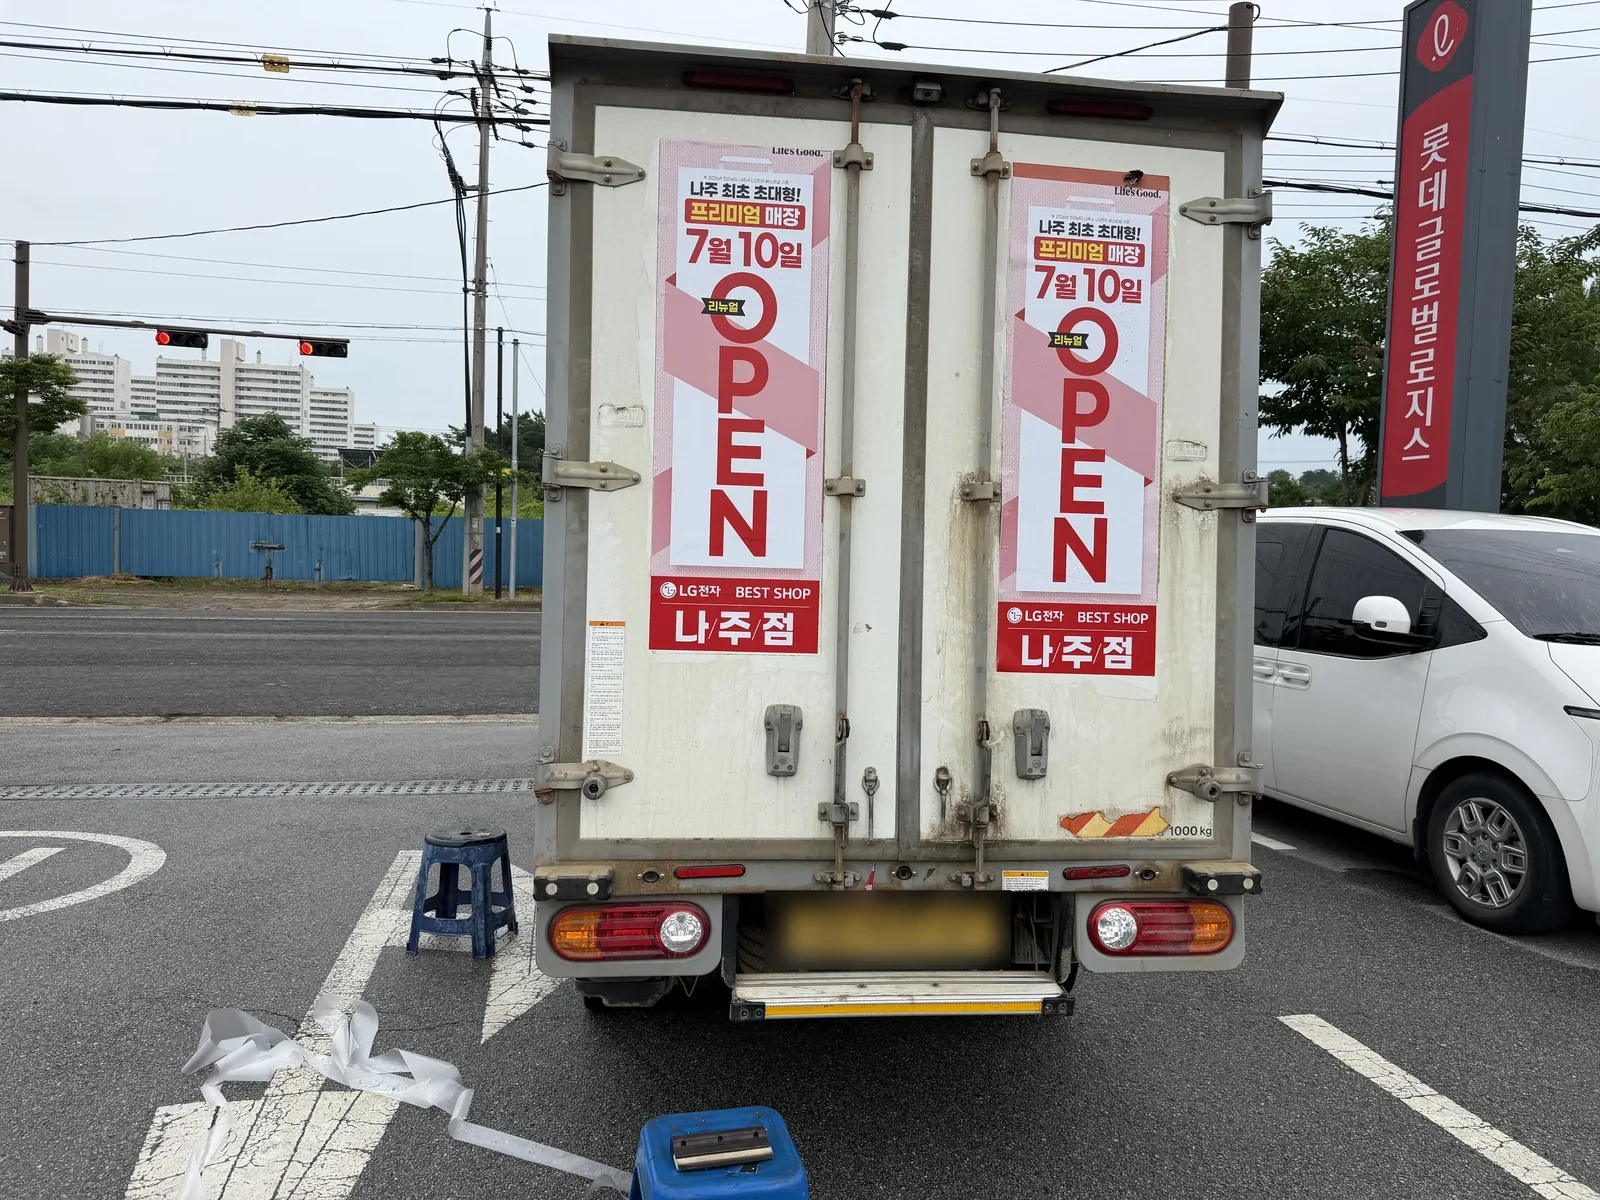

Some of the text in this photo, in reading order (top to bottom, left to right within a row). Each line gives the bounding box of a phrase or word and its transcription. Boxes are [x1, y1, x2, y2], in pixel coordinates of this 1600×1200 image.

[690, 181, 801, 203] 나주 최초 초대형!
[1114, 186, 1161, 199] Life's Good.
[690, 202, 800, 227] 프리미엄 매장
[1039, 219, 1065, 236] 나주
[1068, 222, 1094, 238] 최초
[1098, 224, 1141, 241] 초대형!
[686, 228, 802, 269] 7월 10일
[1039, 239, 1140, 264] 프리미엄 매장
[1034, 265, 1142, 304] 7월 10일
[1402, 122, 1449, 461] 롯데글로벌로지스
[708, 301, 739, 313] 리뉴얼
[1054, 334, 1083, 347] 리뉴얼
[708, 271, 778, 558] OPEN
[1053, 307, 1119, 584] OPEN
[735, 586, 770, 599] BEST
[774, 587, 811, 600] SHOP
[1077, 611, 1110, 623] BEST
[1113, 612, 1149, 625] SHOP
[1169, 825, 1198, 836] 1000
[1200, 826, 1212, 837] kg
